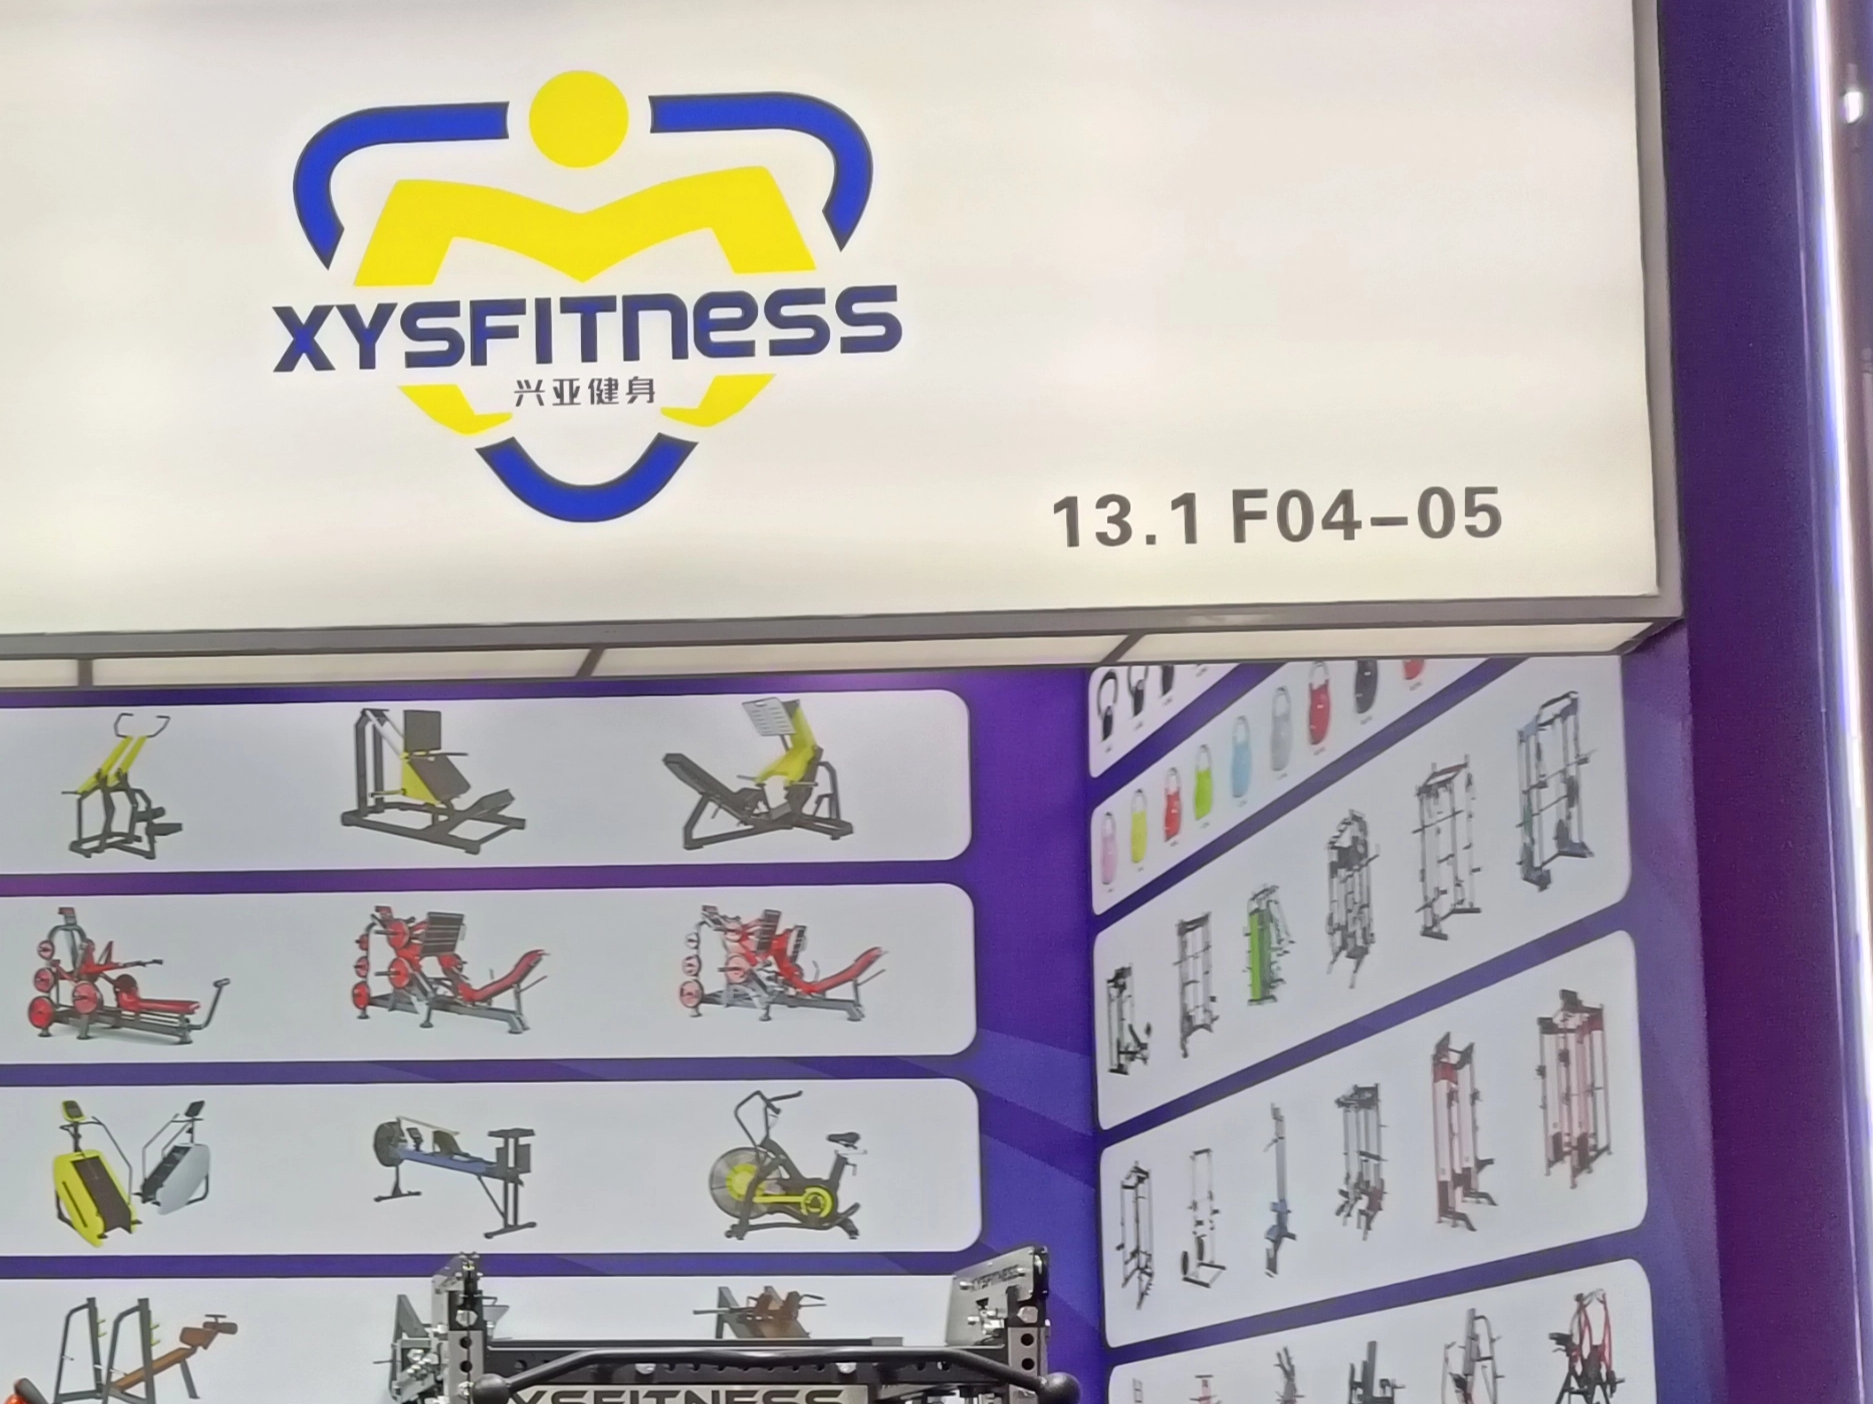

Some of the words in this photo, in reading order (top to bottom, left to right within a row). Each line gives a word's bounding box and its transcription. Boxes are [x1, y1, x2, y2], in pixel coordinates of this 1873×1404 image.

[513, 375, 657, 407] 兴亚健身
[1053, 492, 1198, 548] 13.1
[1231, 485, 1503, 543] F04-05
